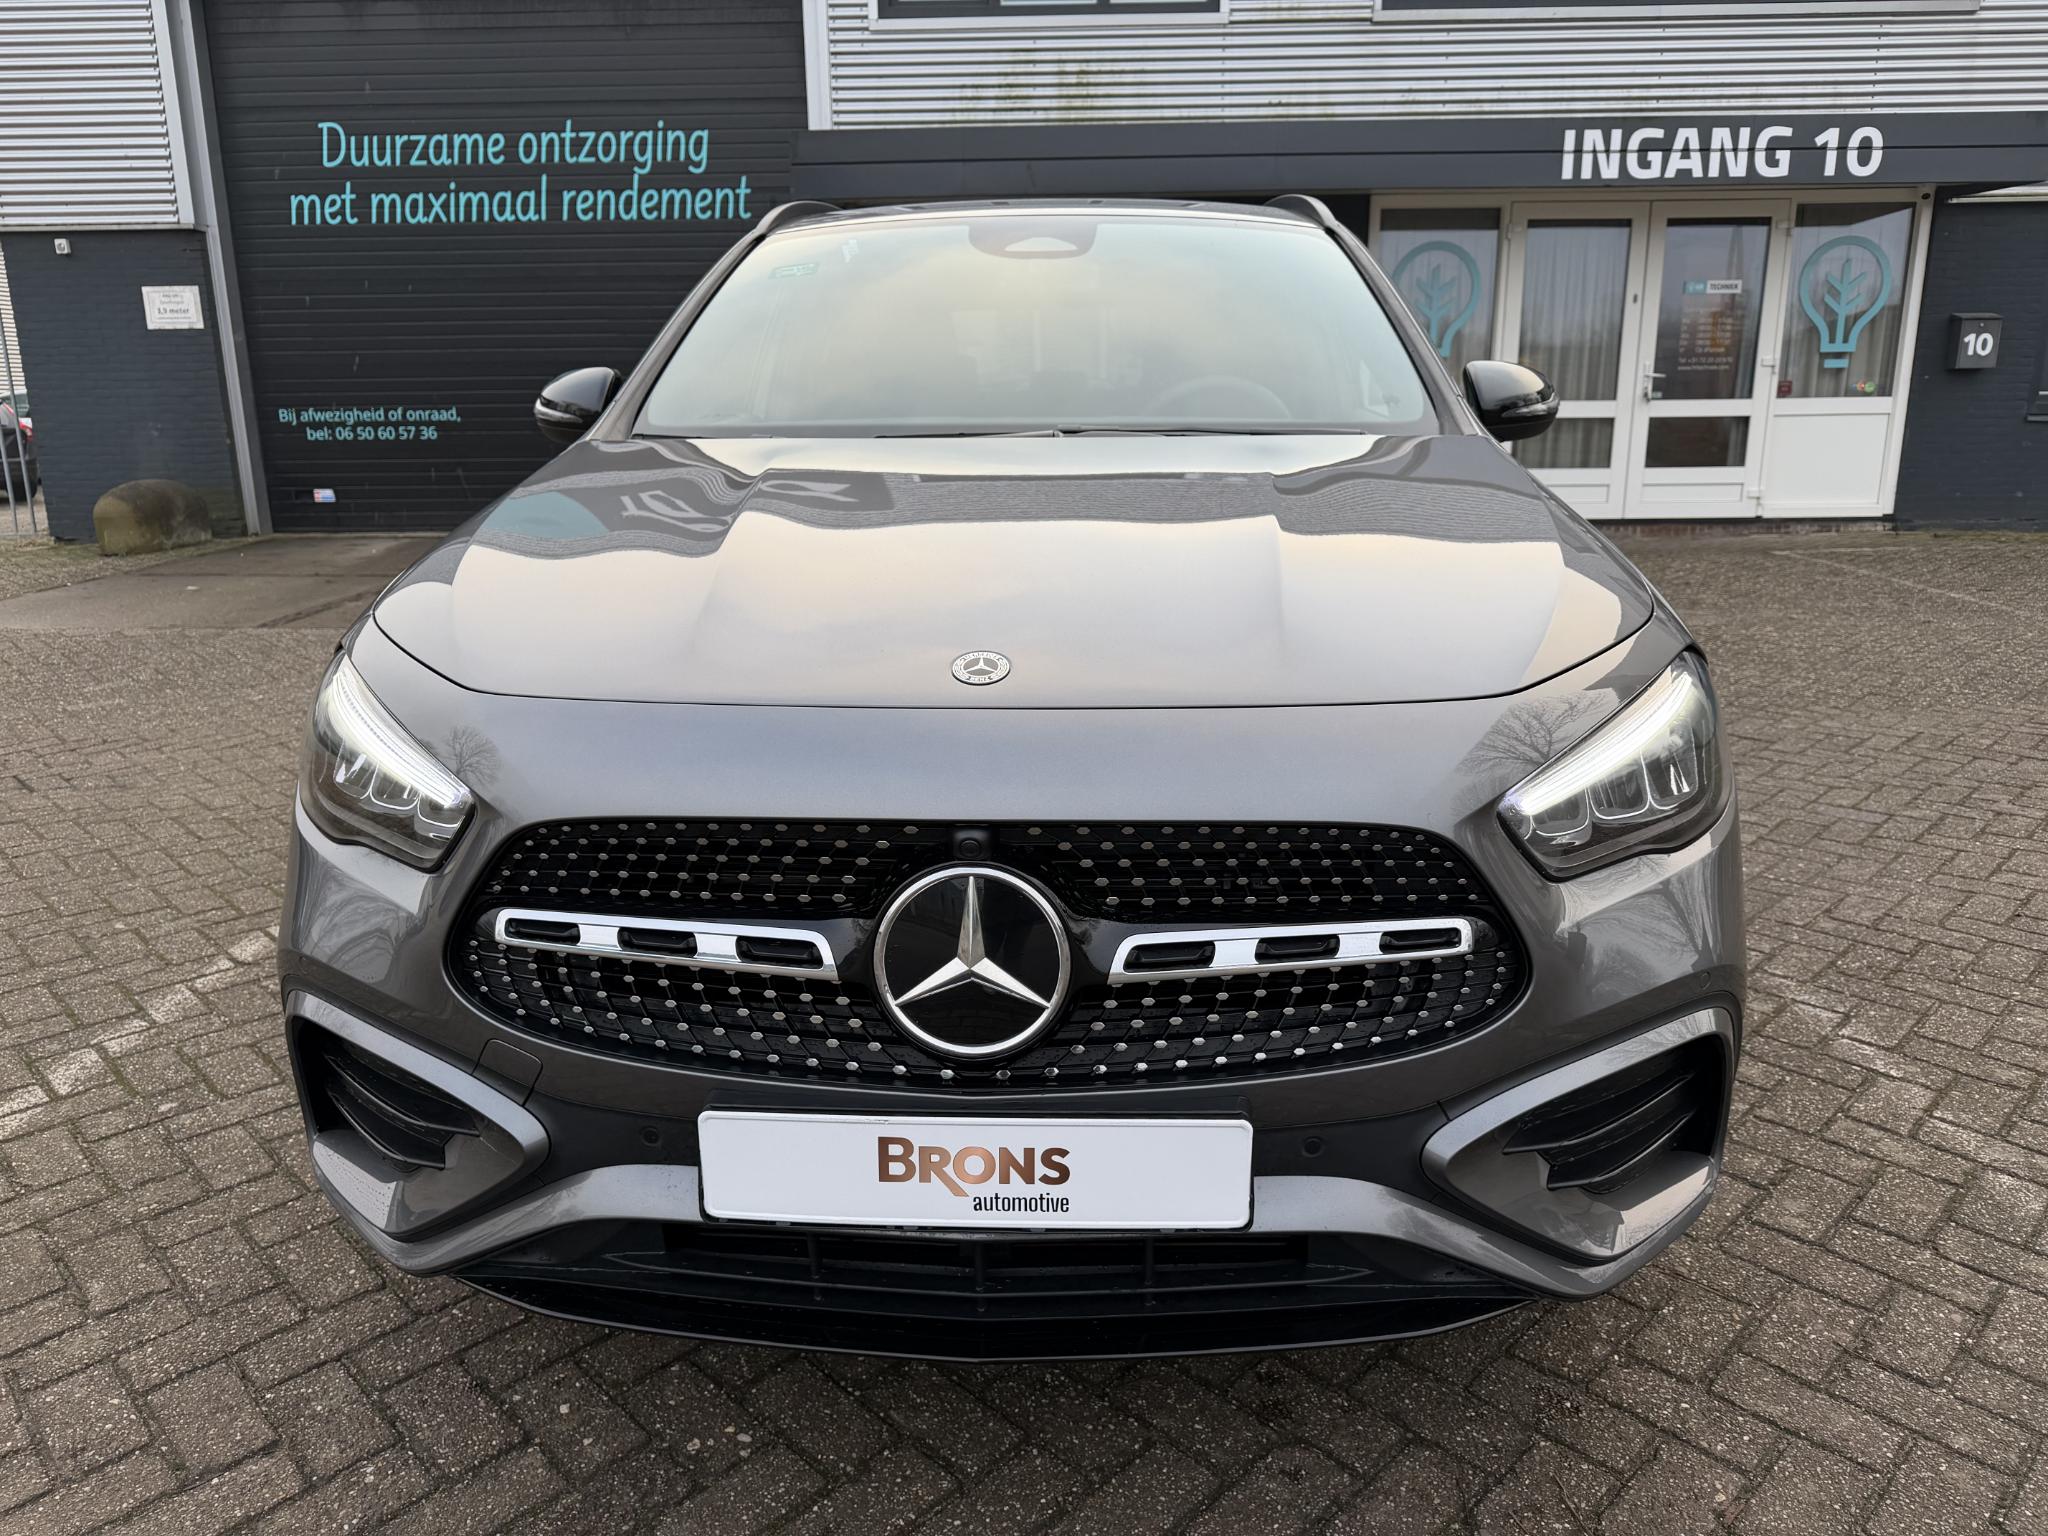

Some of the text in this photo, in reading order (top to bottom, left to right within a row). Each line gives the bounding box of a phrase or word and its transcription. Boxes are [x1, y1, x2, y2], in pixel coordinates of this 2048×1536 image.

[317, 119, 709, 174] Duurzame ontzorging
[1562, 126, 1884, 180] INGANG 10
[290, 173, 752, 225] met maximaal rendement
[1964, 332, 1994, 356] 10
[278, 407, 461, 426] Bij afwezigheid of onraad,
[306, 425, 438, 441] bel: 06 50 60 57 36
[878, 1136, 1071, 1197] BRONS
[973, 1193, 1070, 1213] automotive
